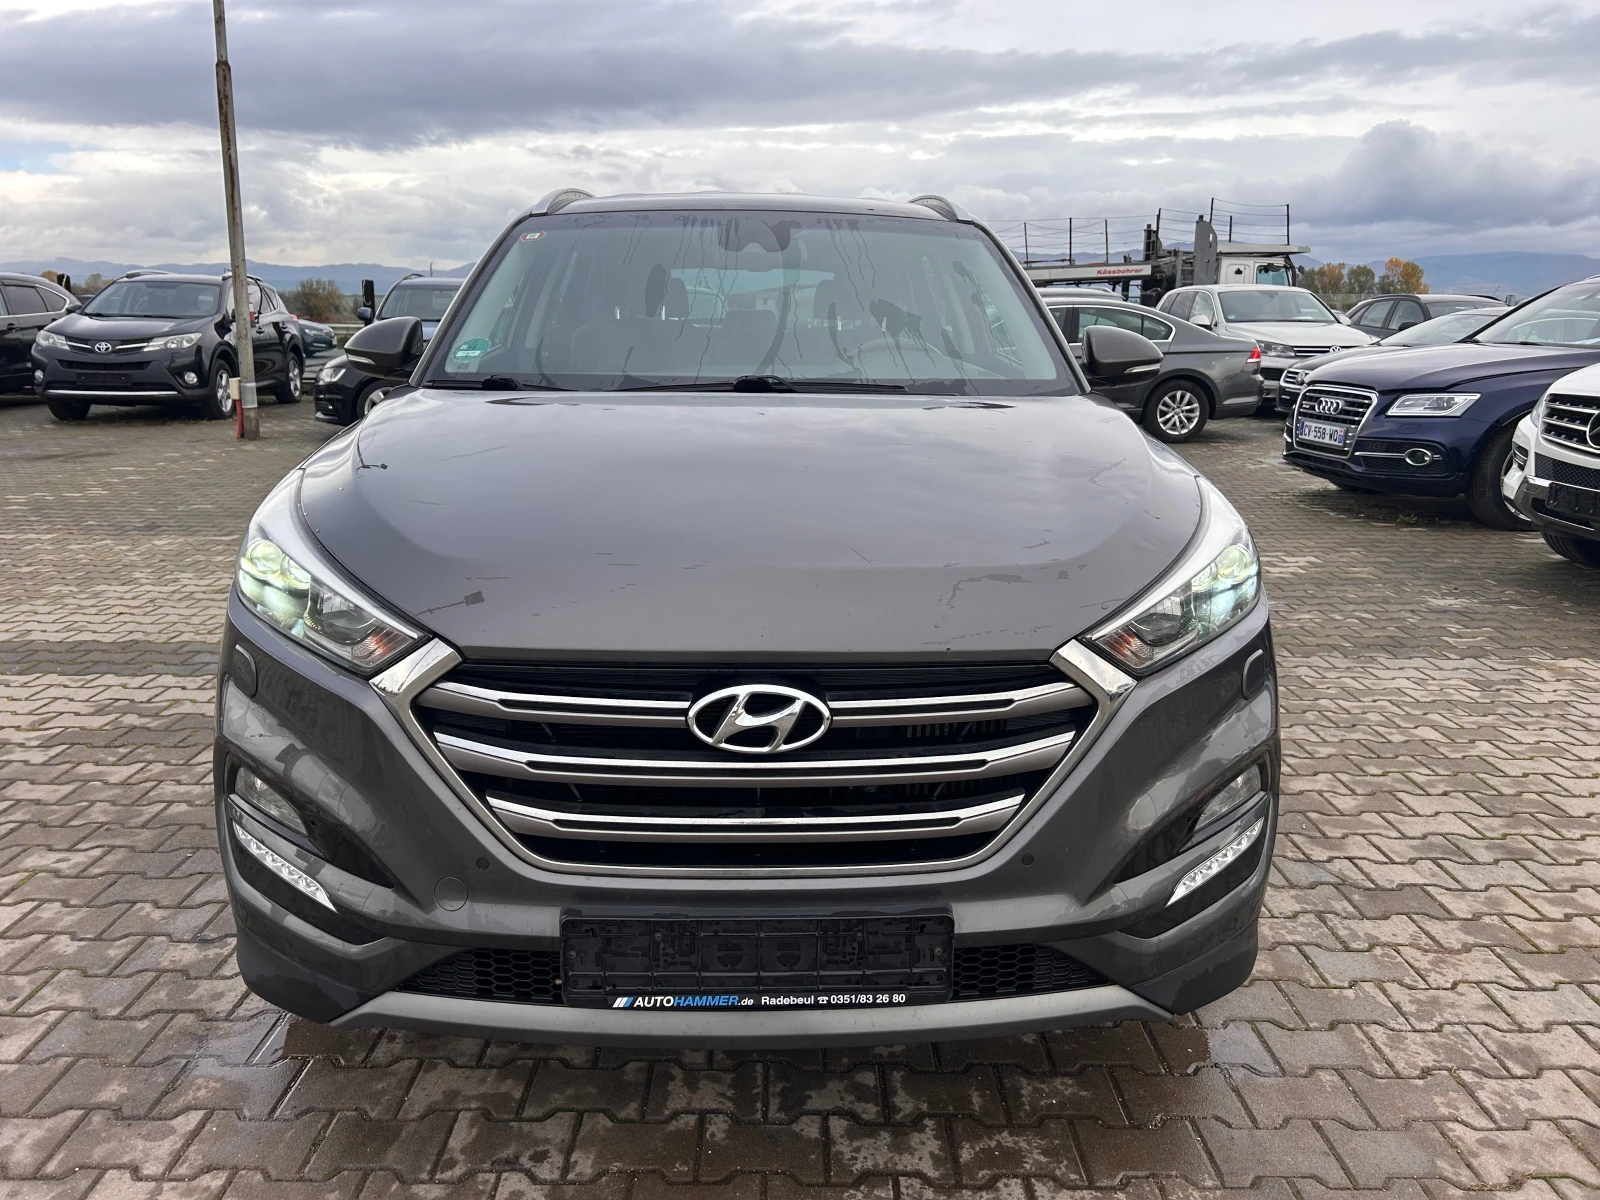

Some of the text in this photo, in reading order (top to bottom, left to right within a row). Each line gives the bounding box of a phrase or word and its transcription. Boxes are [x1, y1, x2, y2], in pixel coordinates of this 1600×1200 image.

[633, 993, 906, 1007] AUTOHAMMER.de Radebeul 0351/83 26 80
